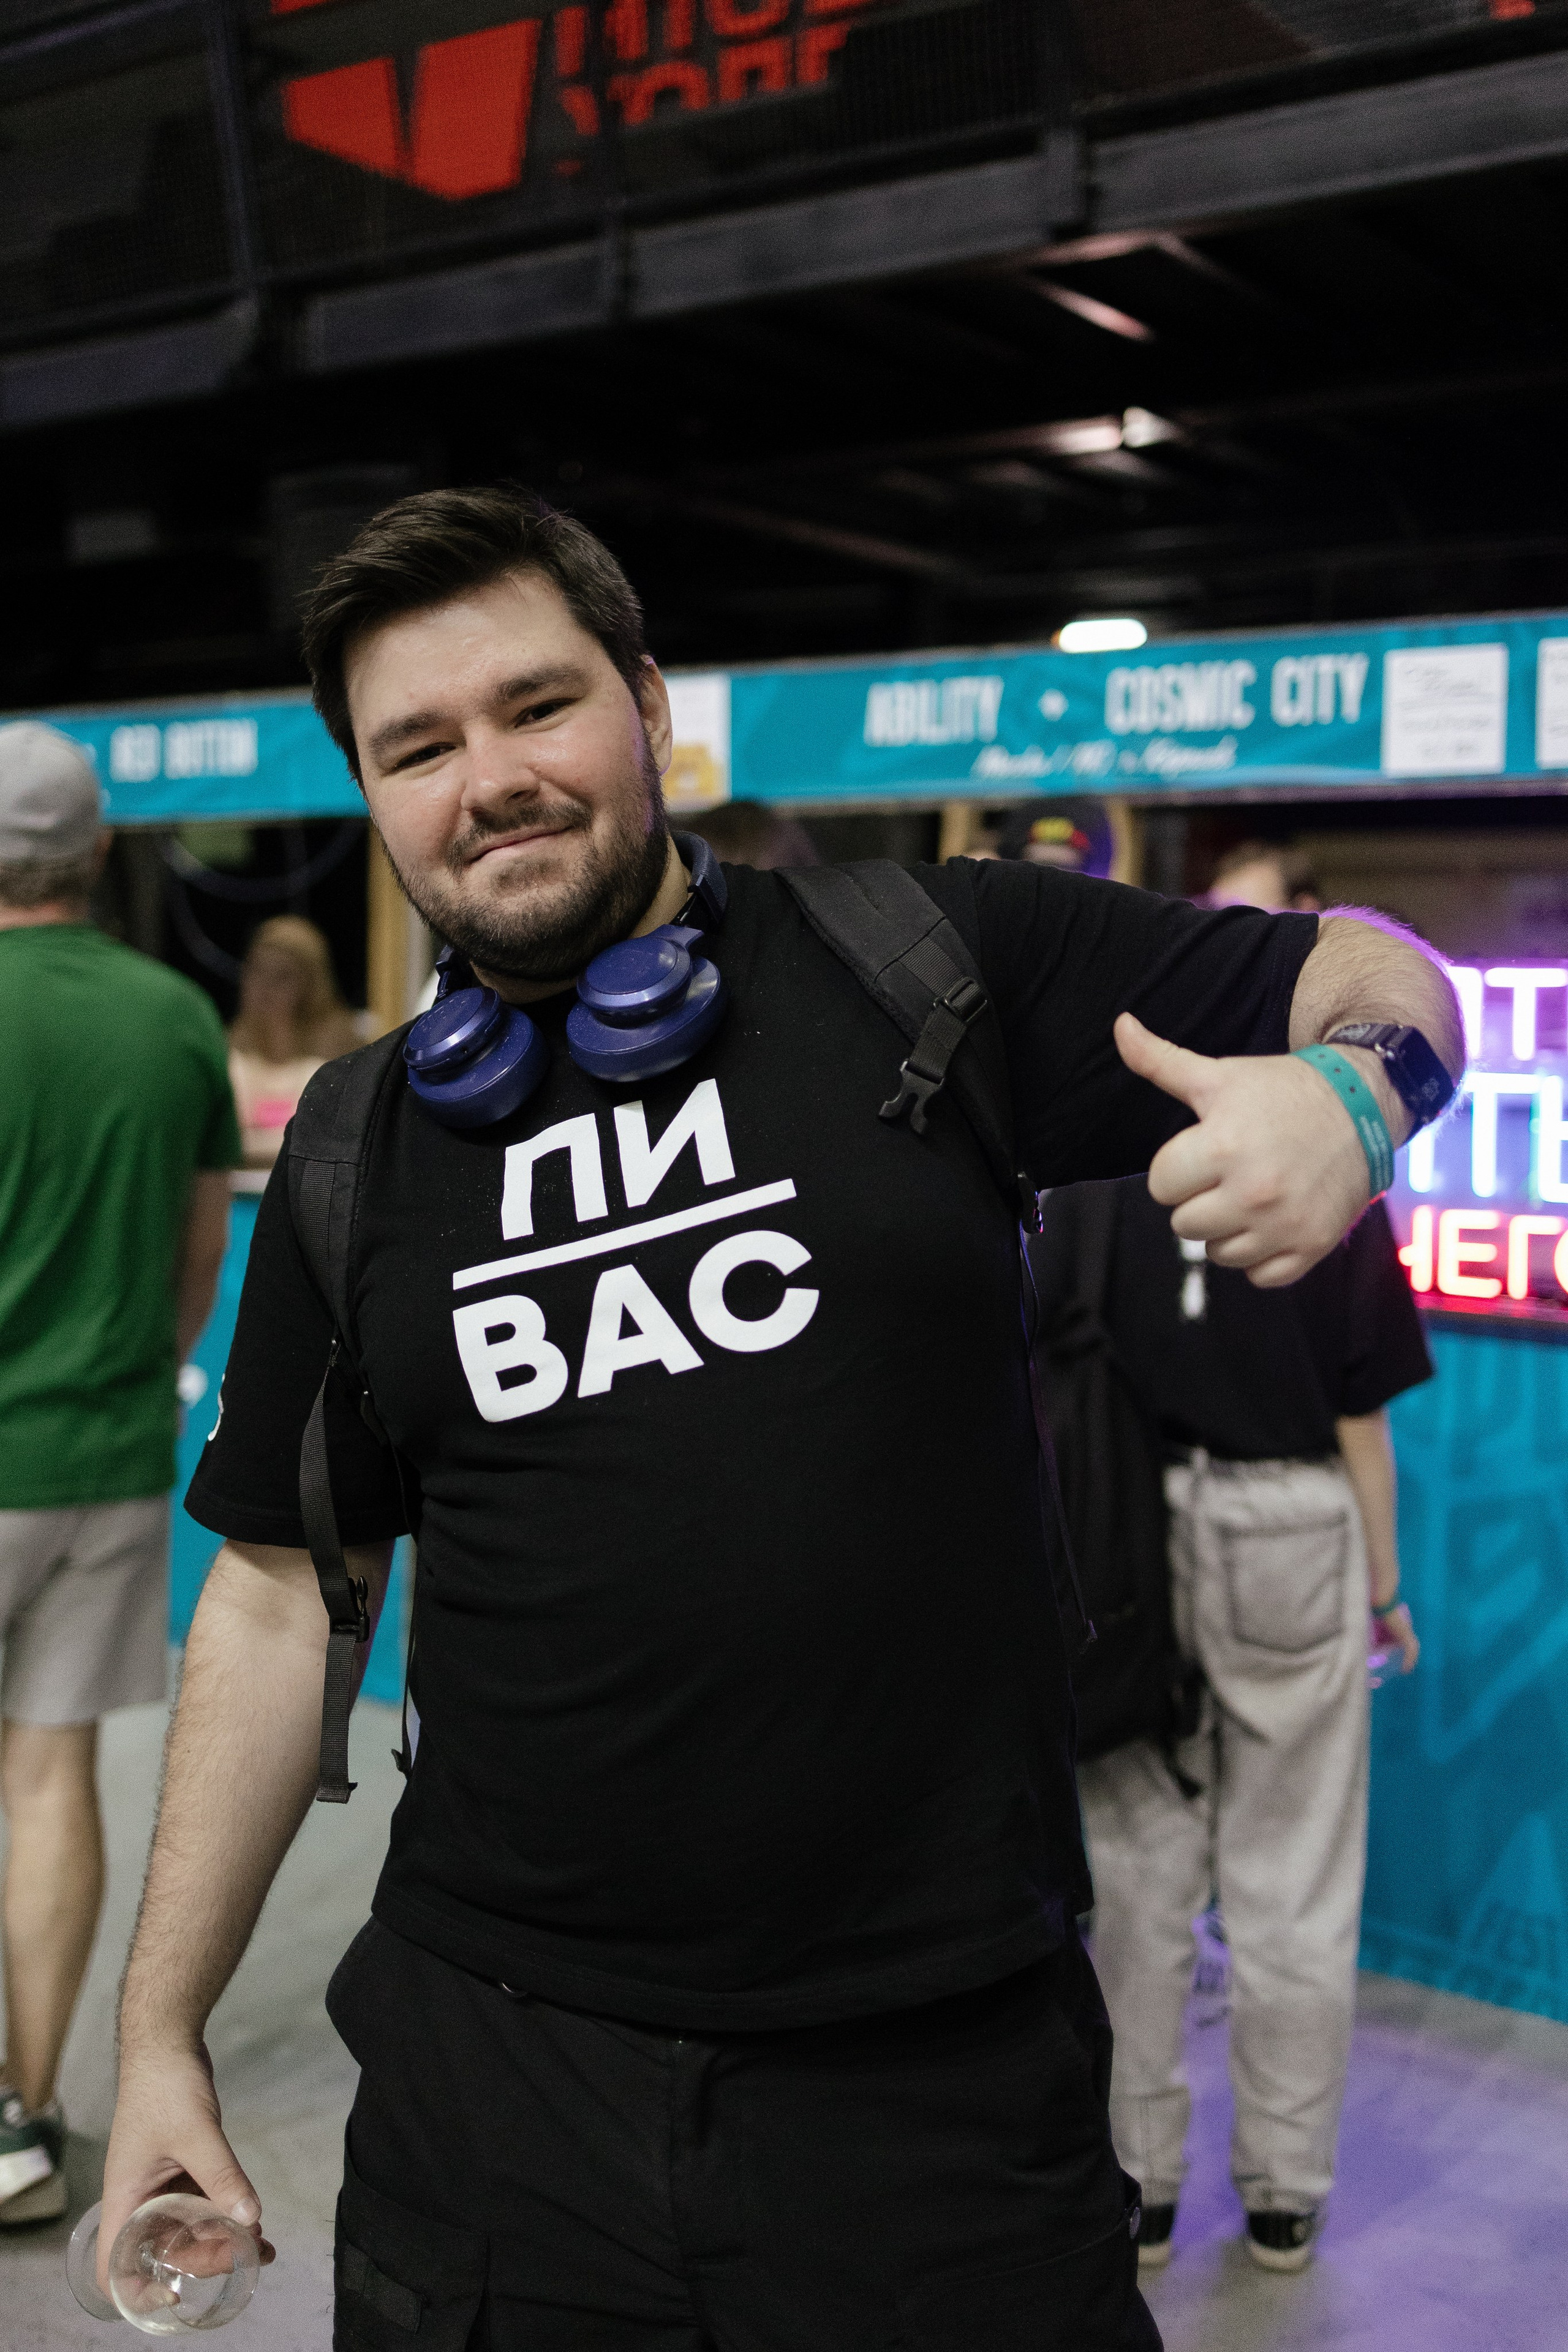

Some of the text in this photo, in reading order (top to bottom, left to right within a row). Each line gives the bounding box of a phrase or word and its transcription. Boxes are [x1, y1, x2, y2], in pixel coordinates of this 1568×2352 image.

[1104, 659, 1257, 735] COSMIC
[1270, 653, 1370, 726] CITY
[500, 1078, 736, 1241] ПИ
[452, 1230, 820, 1423] ВАС
